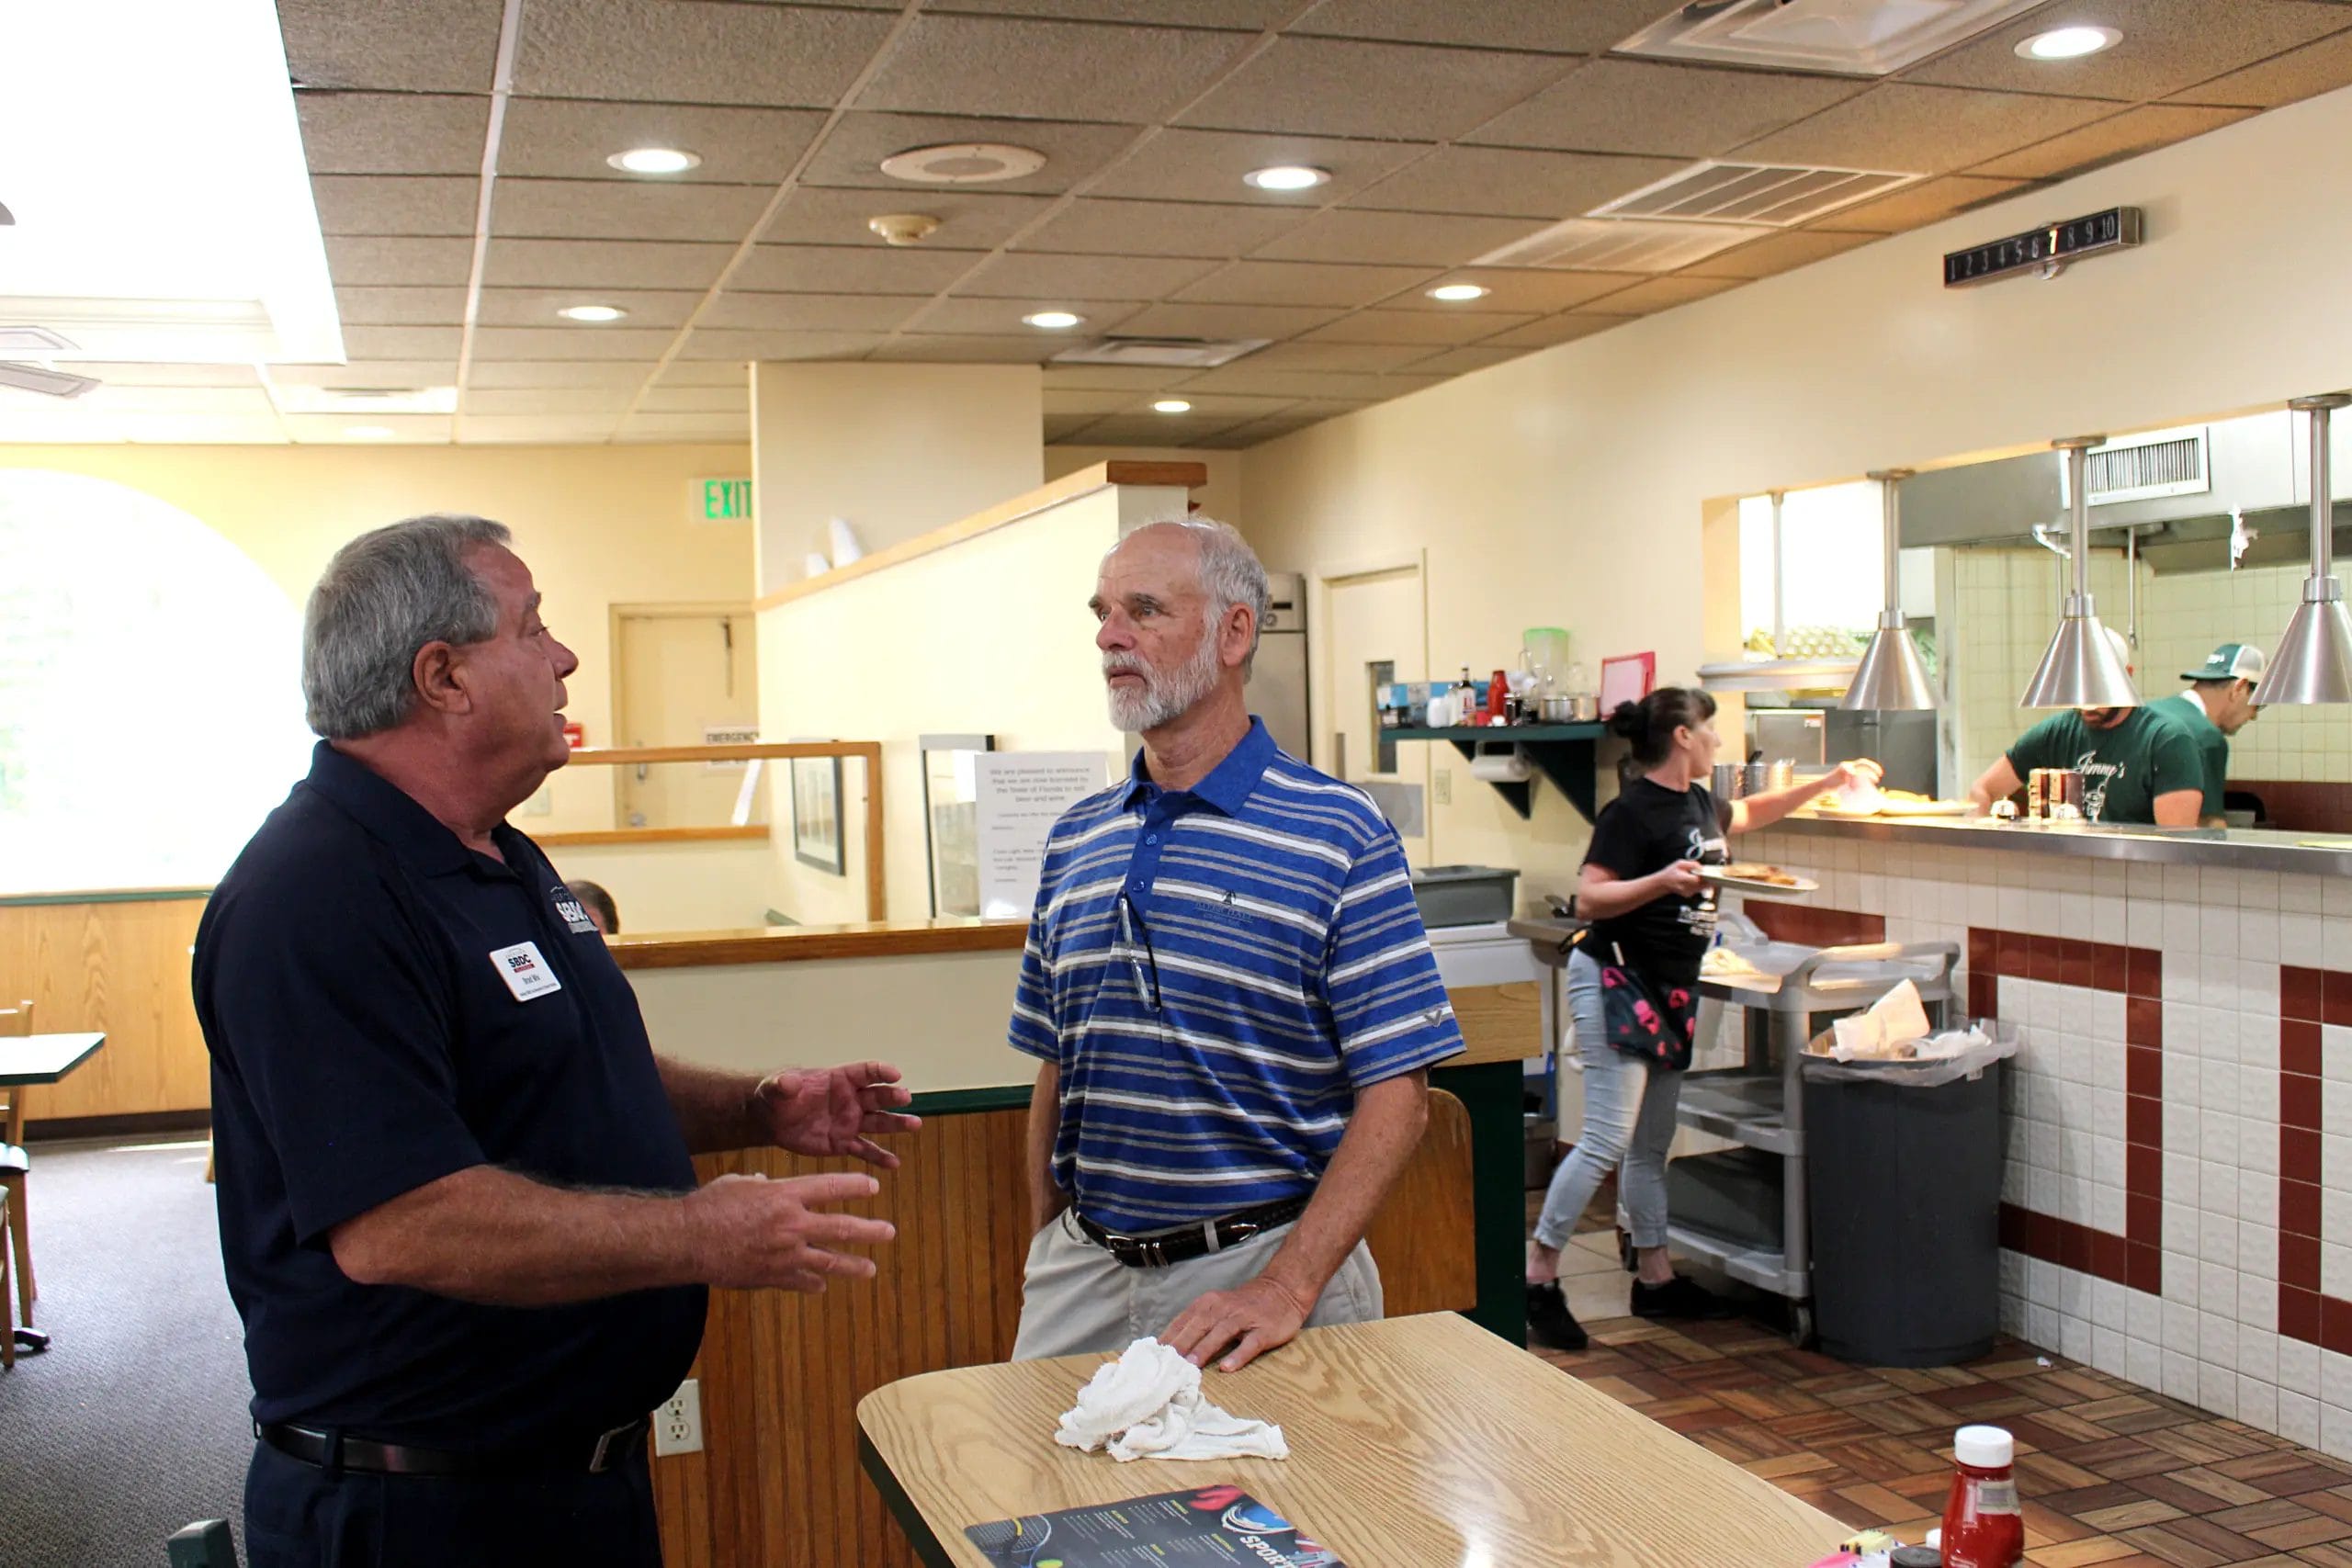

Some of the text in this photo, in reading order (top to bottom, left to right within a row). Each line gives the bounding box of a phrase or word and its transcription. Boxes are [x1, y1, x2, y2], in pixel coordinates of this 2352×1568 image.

[2101, 214, 2115, 240] 10
[705, 480, 752, 519] EXIT
[2072, 750, 2126, 783] Jimmy's
[508, 953, 531, 968] SBDC
